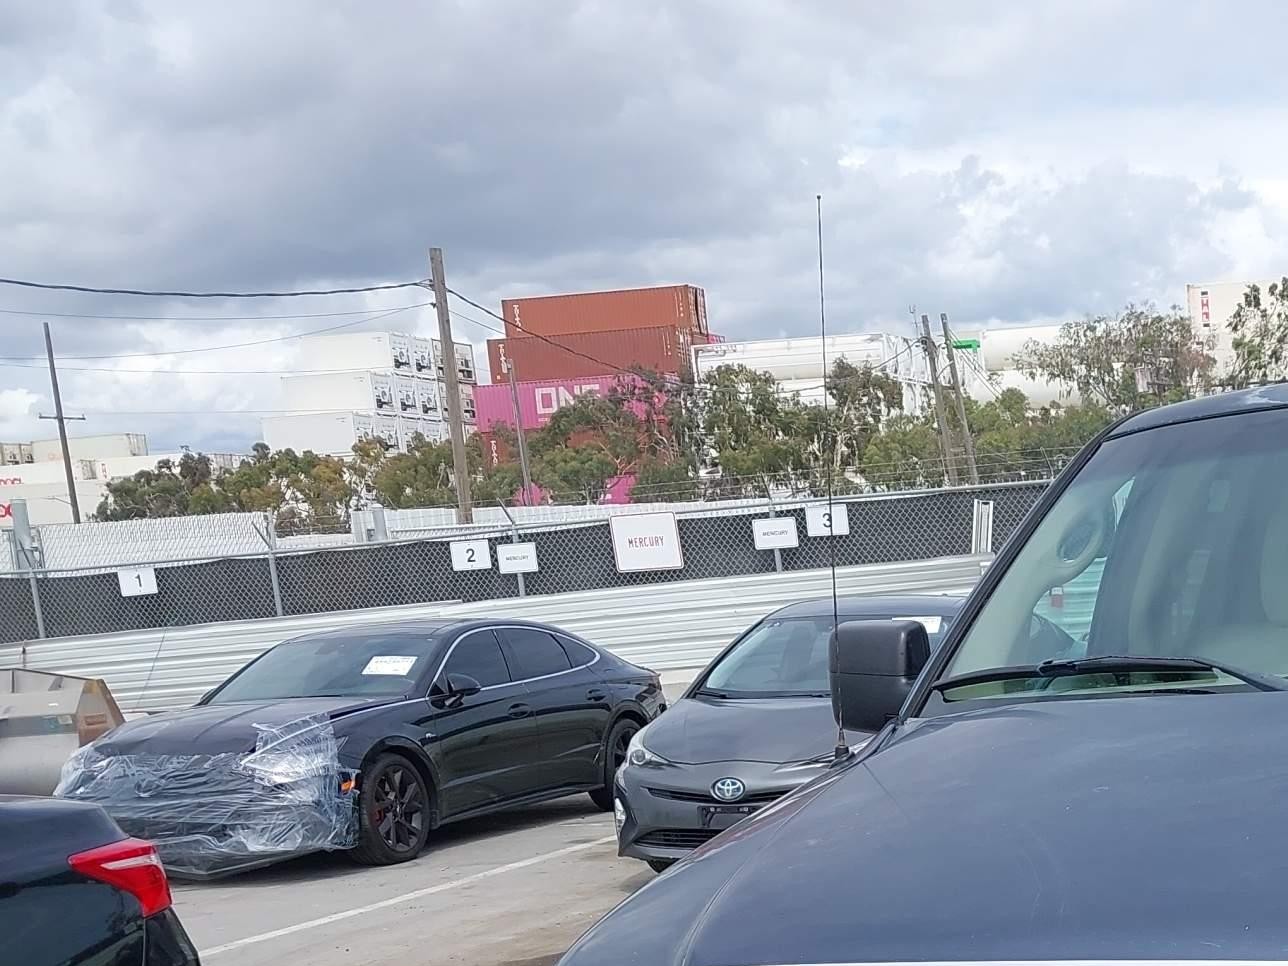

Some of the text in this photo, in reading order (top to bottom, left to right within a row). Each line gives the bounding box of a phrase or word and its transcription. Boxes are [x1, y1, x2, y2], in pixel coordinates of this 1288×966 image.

[823, 513, 832, 527] 3
[627, 535, 665, 549] MERCURY
[465, 548, 476, 563] 2
[135, 574, 142, 588] 1
